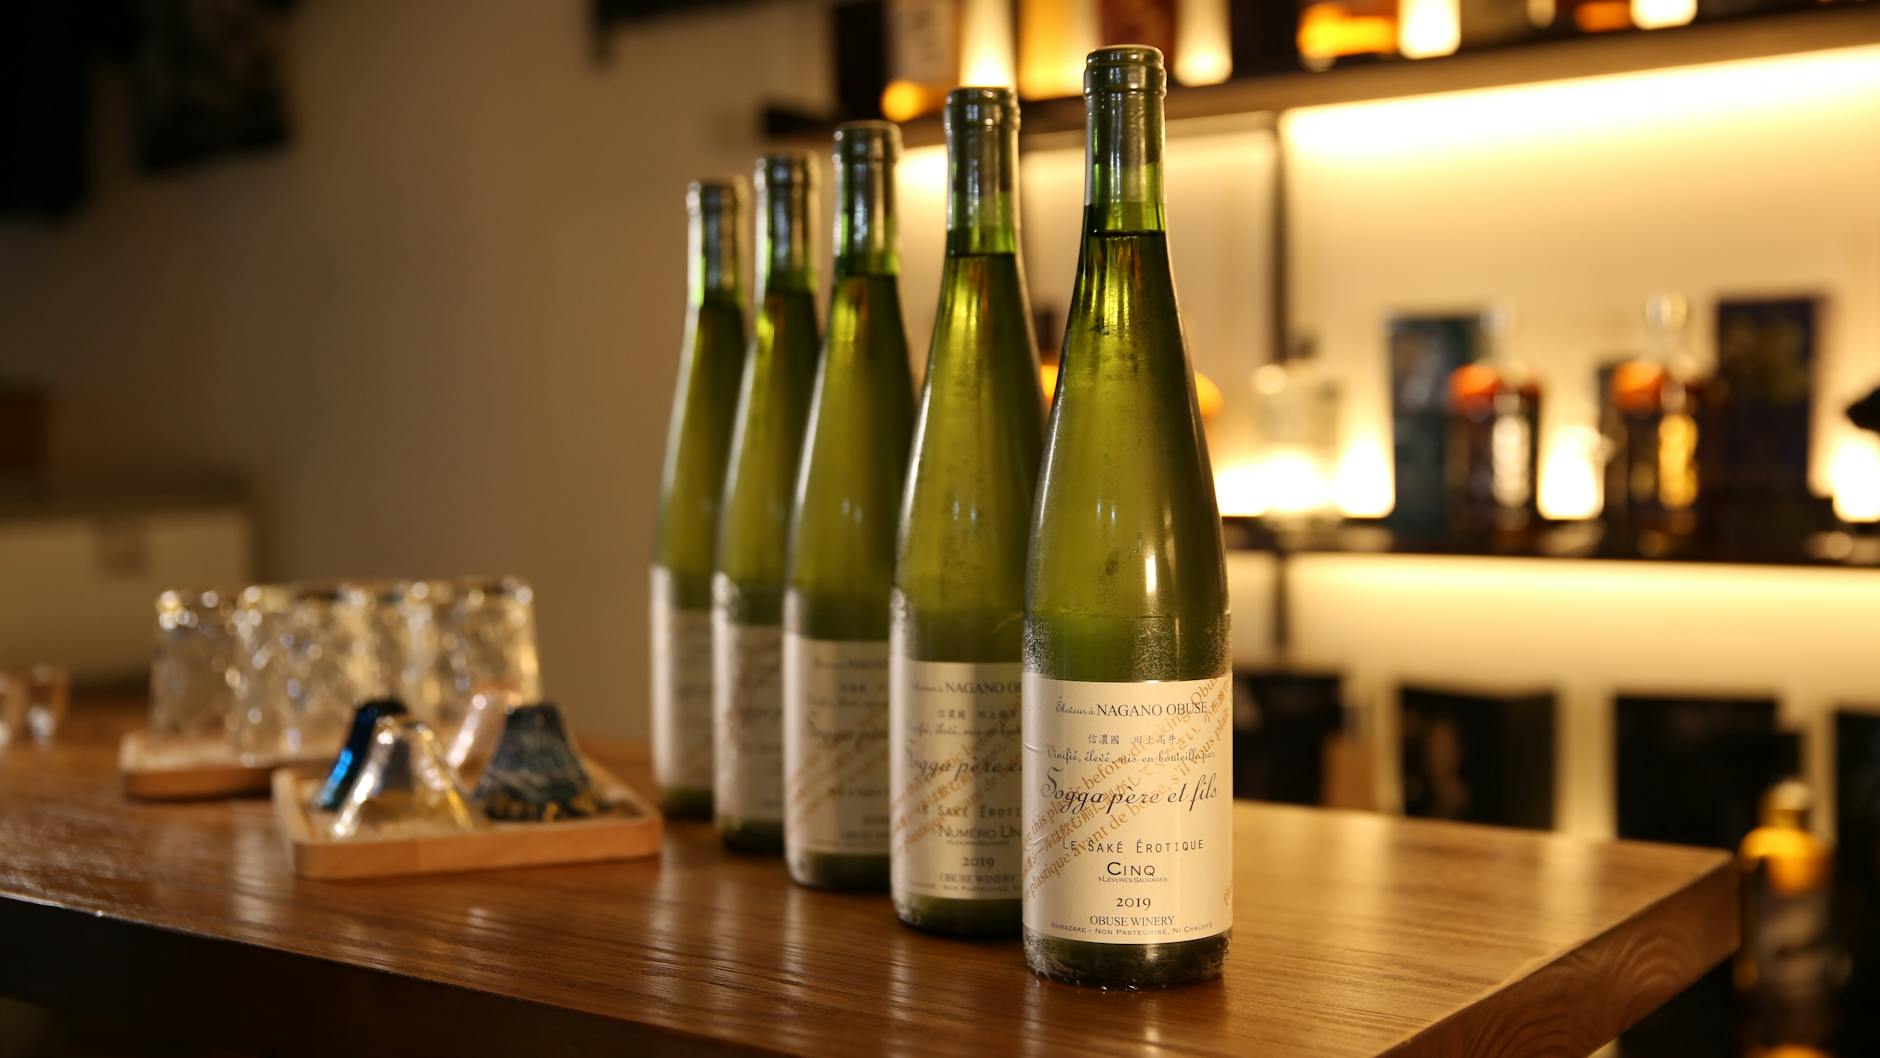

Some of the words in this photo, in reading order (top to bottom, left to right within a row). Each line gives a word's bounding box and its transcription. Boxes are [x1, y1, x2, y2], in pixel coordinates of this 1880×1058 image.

[1096, 703, 1162, 716] NAGANO
[1166, 701, 1208, 715] OBUSE
[1142, 755, 1154, 763] en
[1041, 766, 1105, 815] Sogga
[1105, 785, 1161, 814] père
[1167, 782, 1188, 803] et
[1188, 772, 1217, 812] fils
[1110, 812, 1128, 830] de
[1062, 837, 1077, 850] LE
[1136, 838, 1203, 853] ÉROTIQUE
[963, 857, 995, 869] 2019
[1107, 861, 1156, 877] CINQ
[1116, 897, 1151, 911] 2019
[1090, 915, 1128, 927] OBUSE
[1131, 915, 1175, 926] WINERY
